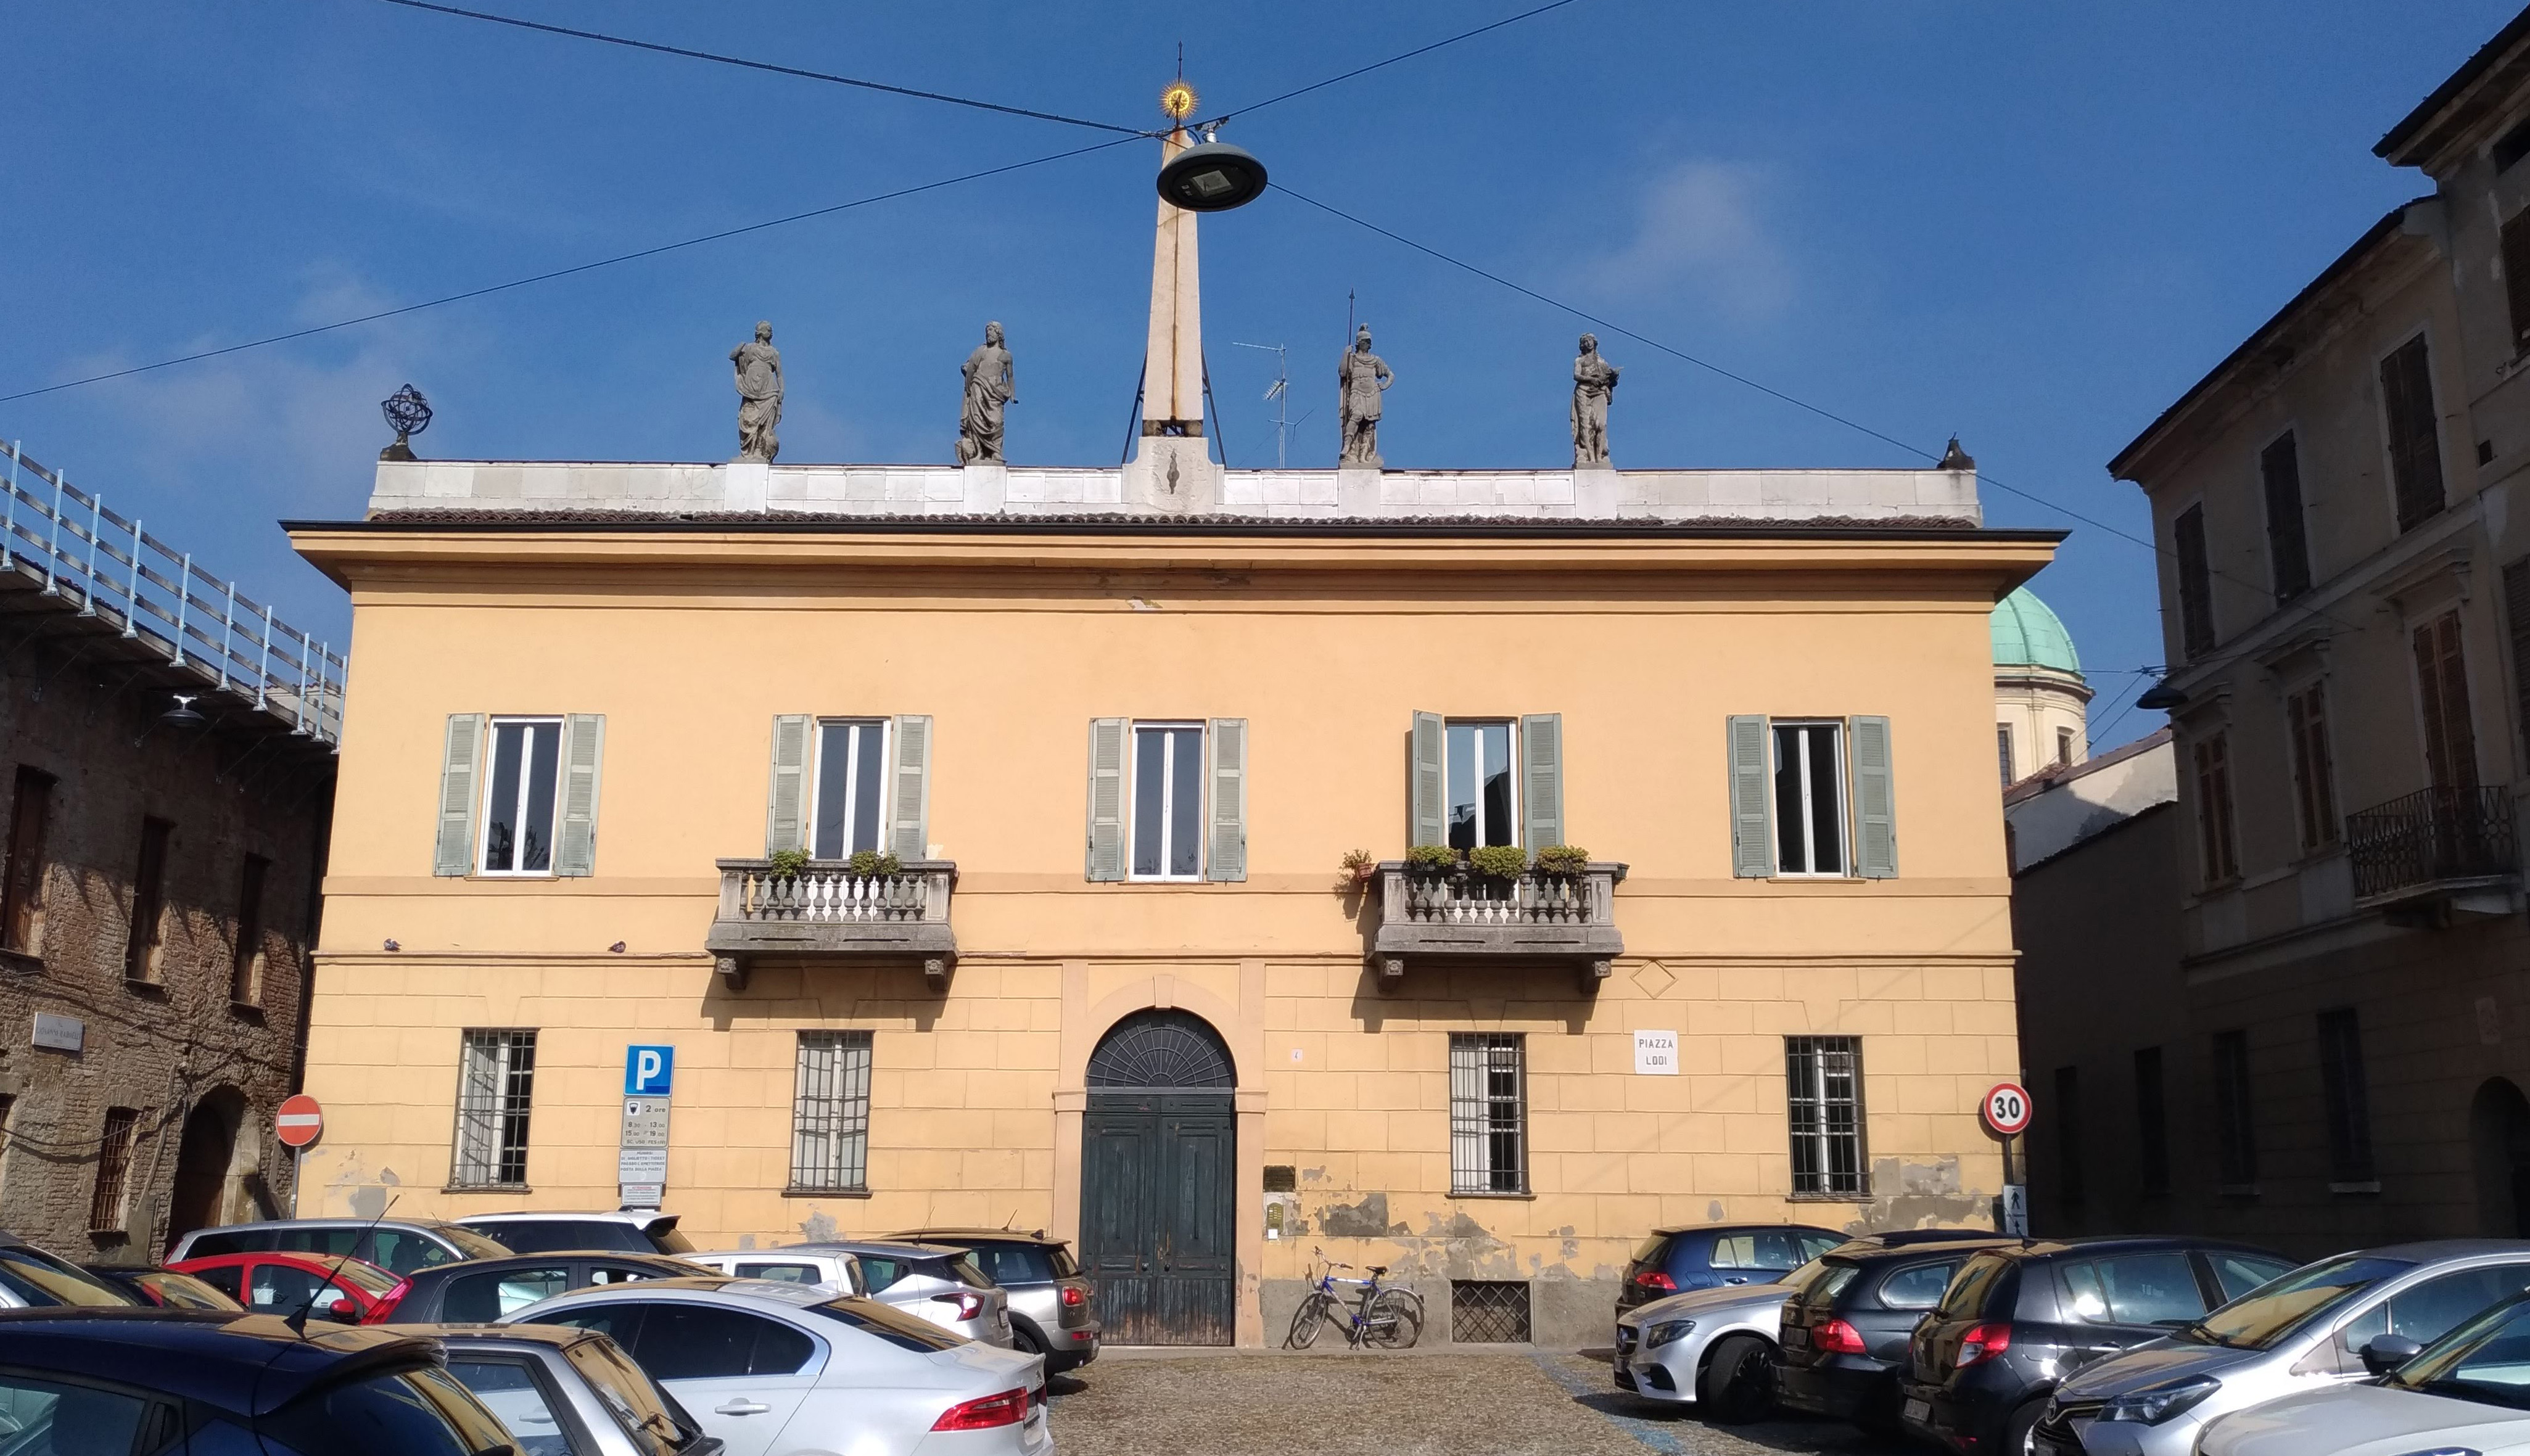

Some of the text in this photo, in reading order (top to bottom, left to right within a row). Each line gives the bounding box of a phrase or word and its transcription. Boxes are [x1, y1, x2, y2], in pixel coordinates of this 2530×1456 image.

[1639, 1039, 1673, 1048] PIAZZA
[1646, 1056, 1667, 1065] LODI
[636, 1050, 661, 1090] P
[645, 1104, 651, 1113] 2
[1995, 1096, 2020, 1119] 30
